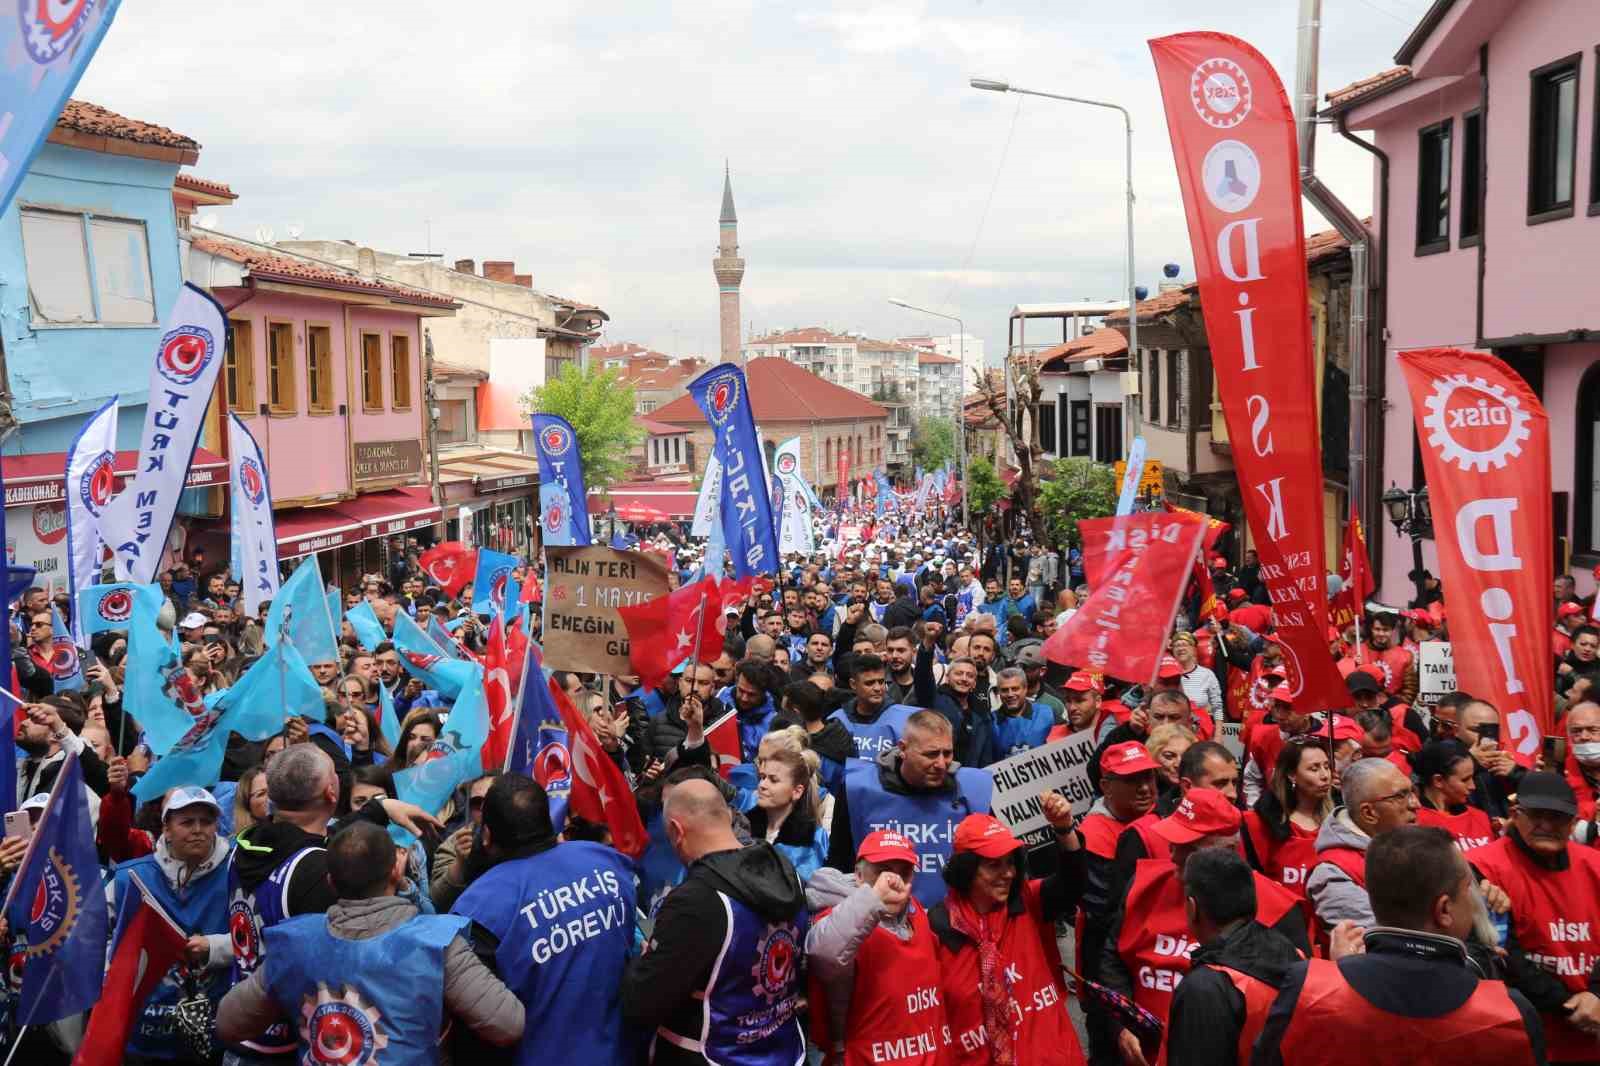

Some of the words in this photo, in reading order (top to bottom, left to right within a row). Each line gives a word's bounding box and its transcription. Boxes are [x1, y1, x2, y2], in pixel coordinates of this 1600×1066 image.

[553, 558, 590, 576] ALIN
[595, 560, 636, 579] TERİ
[576, 585, 588, 607] 1
[551, 613, 615, 635] EMEĞİN
[606, 638, 630, 657] GÜ
[1424, 664, 1448, 673] TAM
[993, 754, 1053, 794] FİLİSTİN
[1050, 739, 1095, 771] HALKI
[1001, 795, 1041, 826] YALNI
[870, 819, 956, 844] TÜRK-İ
[520, 867, 620, 930] TÜRK-İŞ
[531, 897, 626, 965] GÖREVLİ
[1549, 918, 1591, 942] DİSK
[1154, 933, 1201, 960] DİS
[906, 986, 940, 1015] DİSK
[871, 1025, 937, 1064] EMEKLİ
